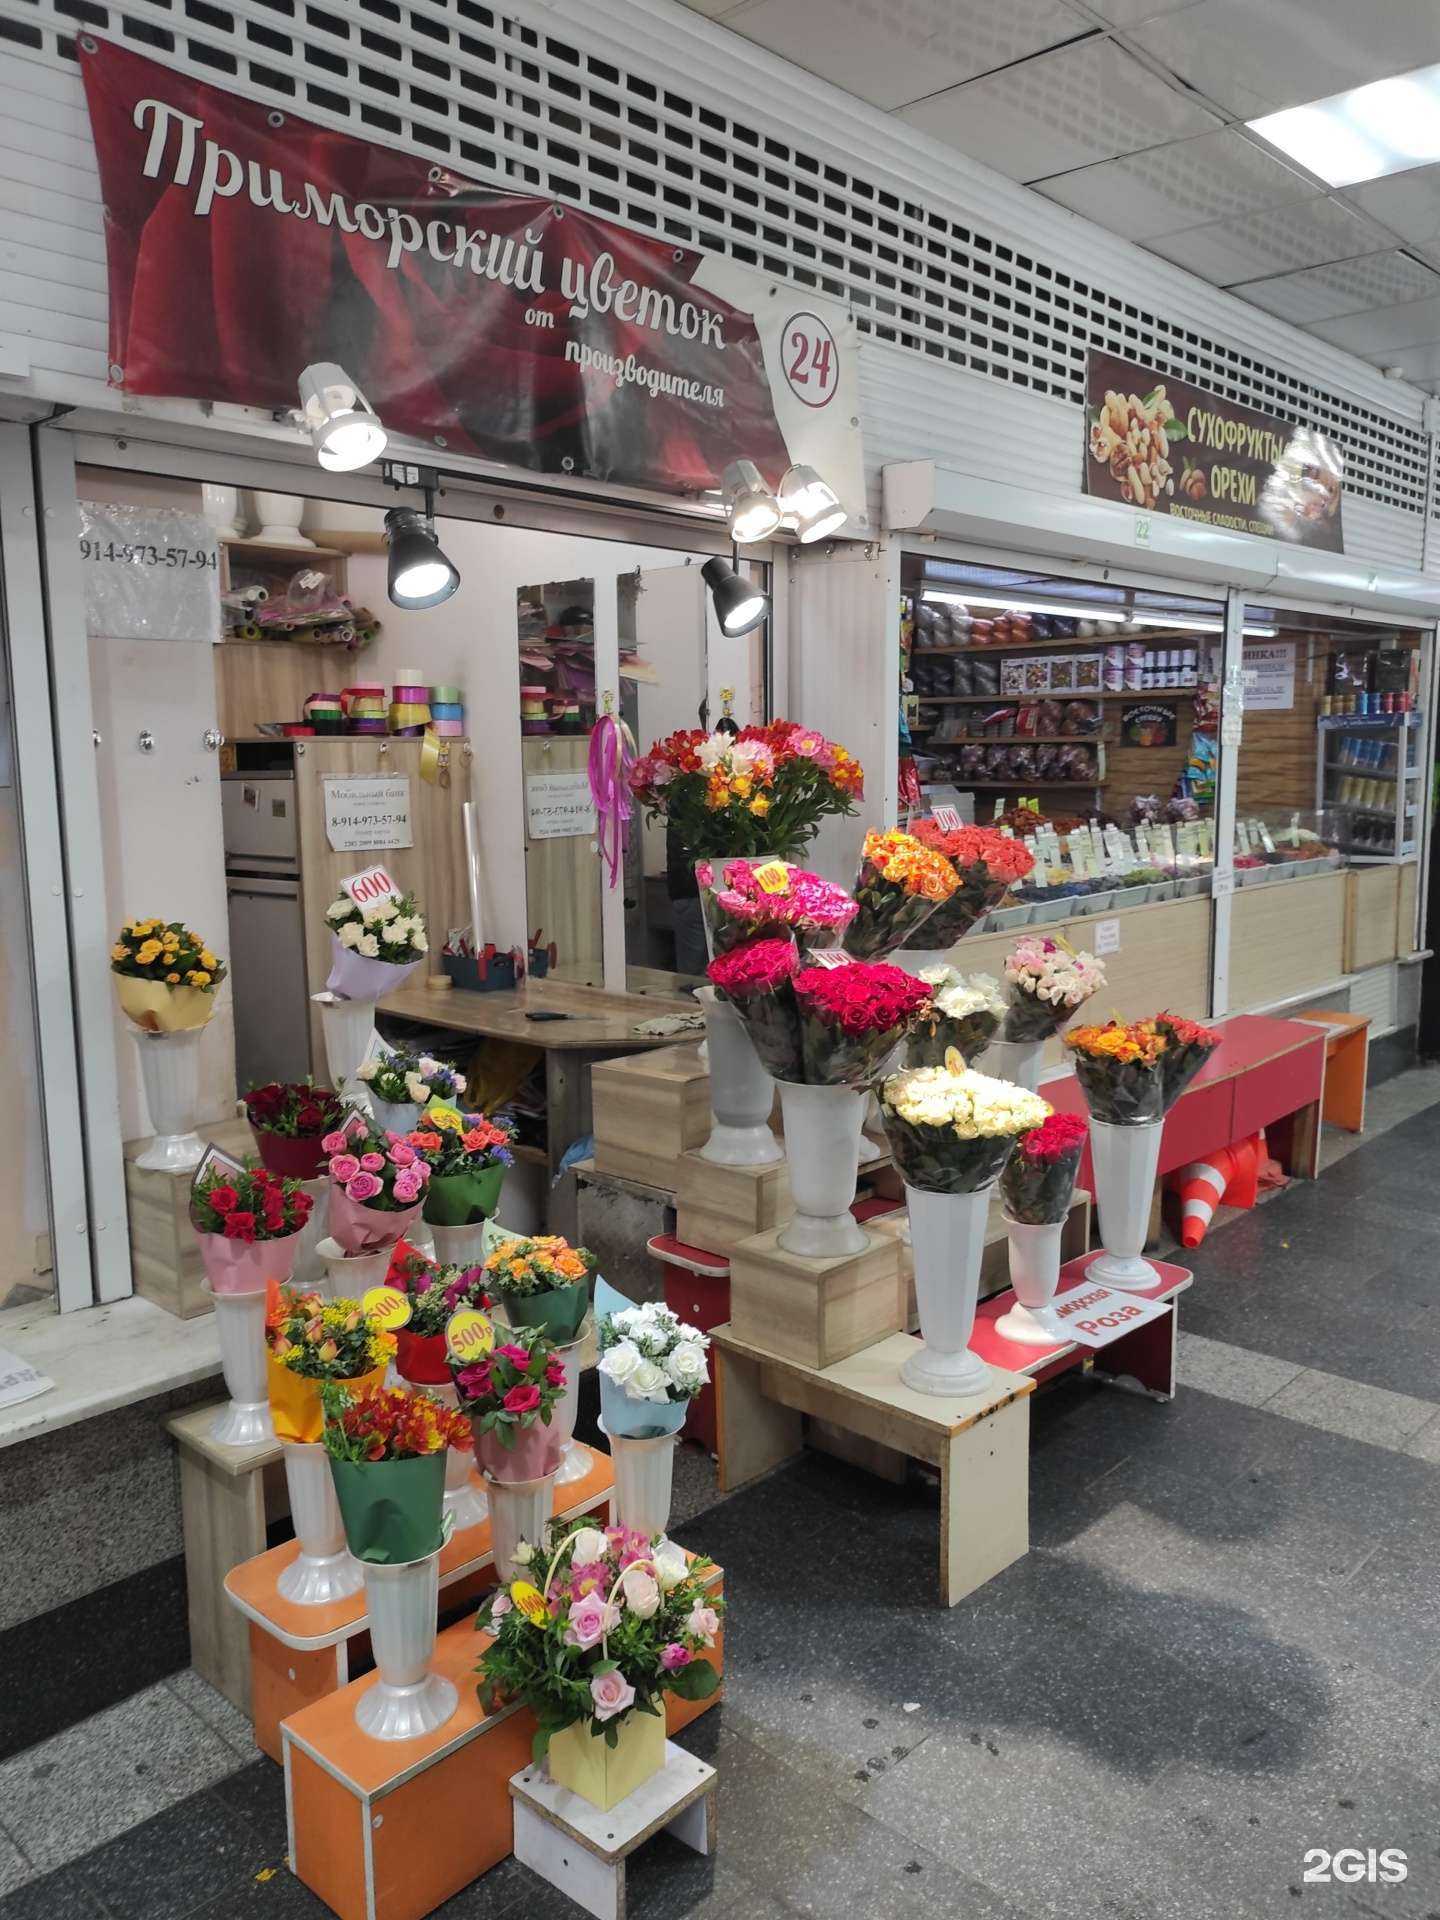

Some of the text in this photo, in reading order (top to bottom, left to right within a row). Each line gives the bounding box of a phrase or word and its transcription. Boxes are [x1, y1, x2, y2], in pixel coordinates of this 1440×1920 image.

[133, 98, 727, 349] Приморский цветок
[525, 307, 555, 329] от
[565, 340, 725, 408] производителя
[789, 331, 831, 388] 24
[1187, 406, 1284, 465] СУХОФРУКТЫ
[1210, 464, 1257, 506] ОРЕХИ
[1136, 518, 1150, 540] 22
[79, 539, 218, 570] 914-973-57-94
[331, 814, 407, 827] 8-914-973-57-94
[351, 871, 391, 903] 600
